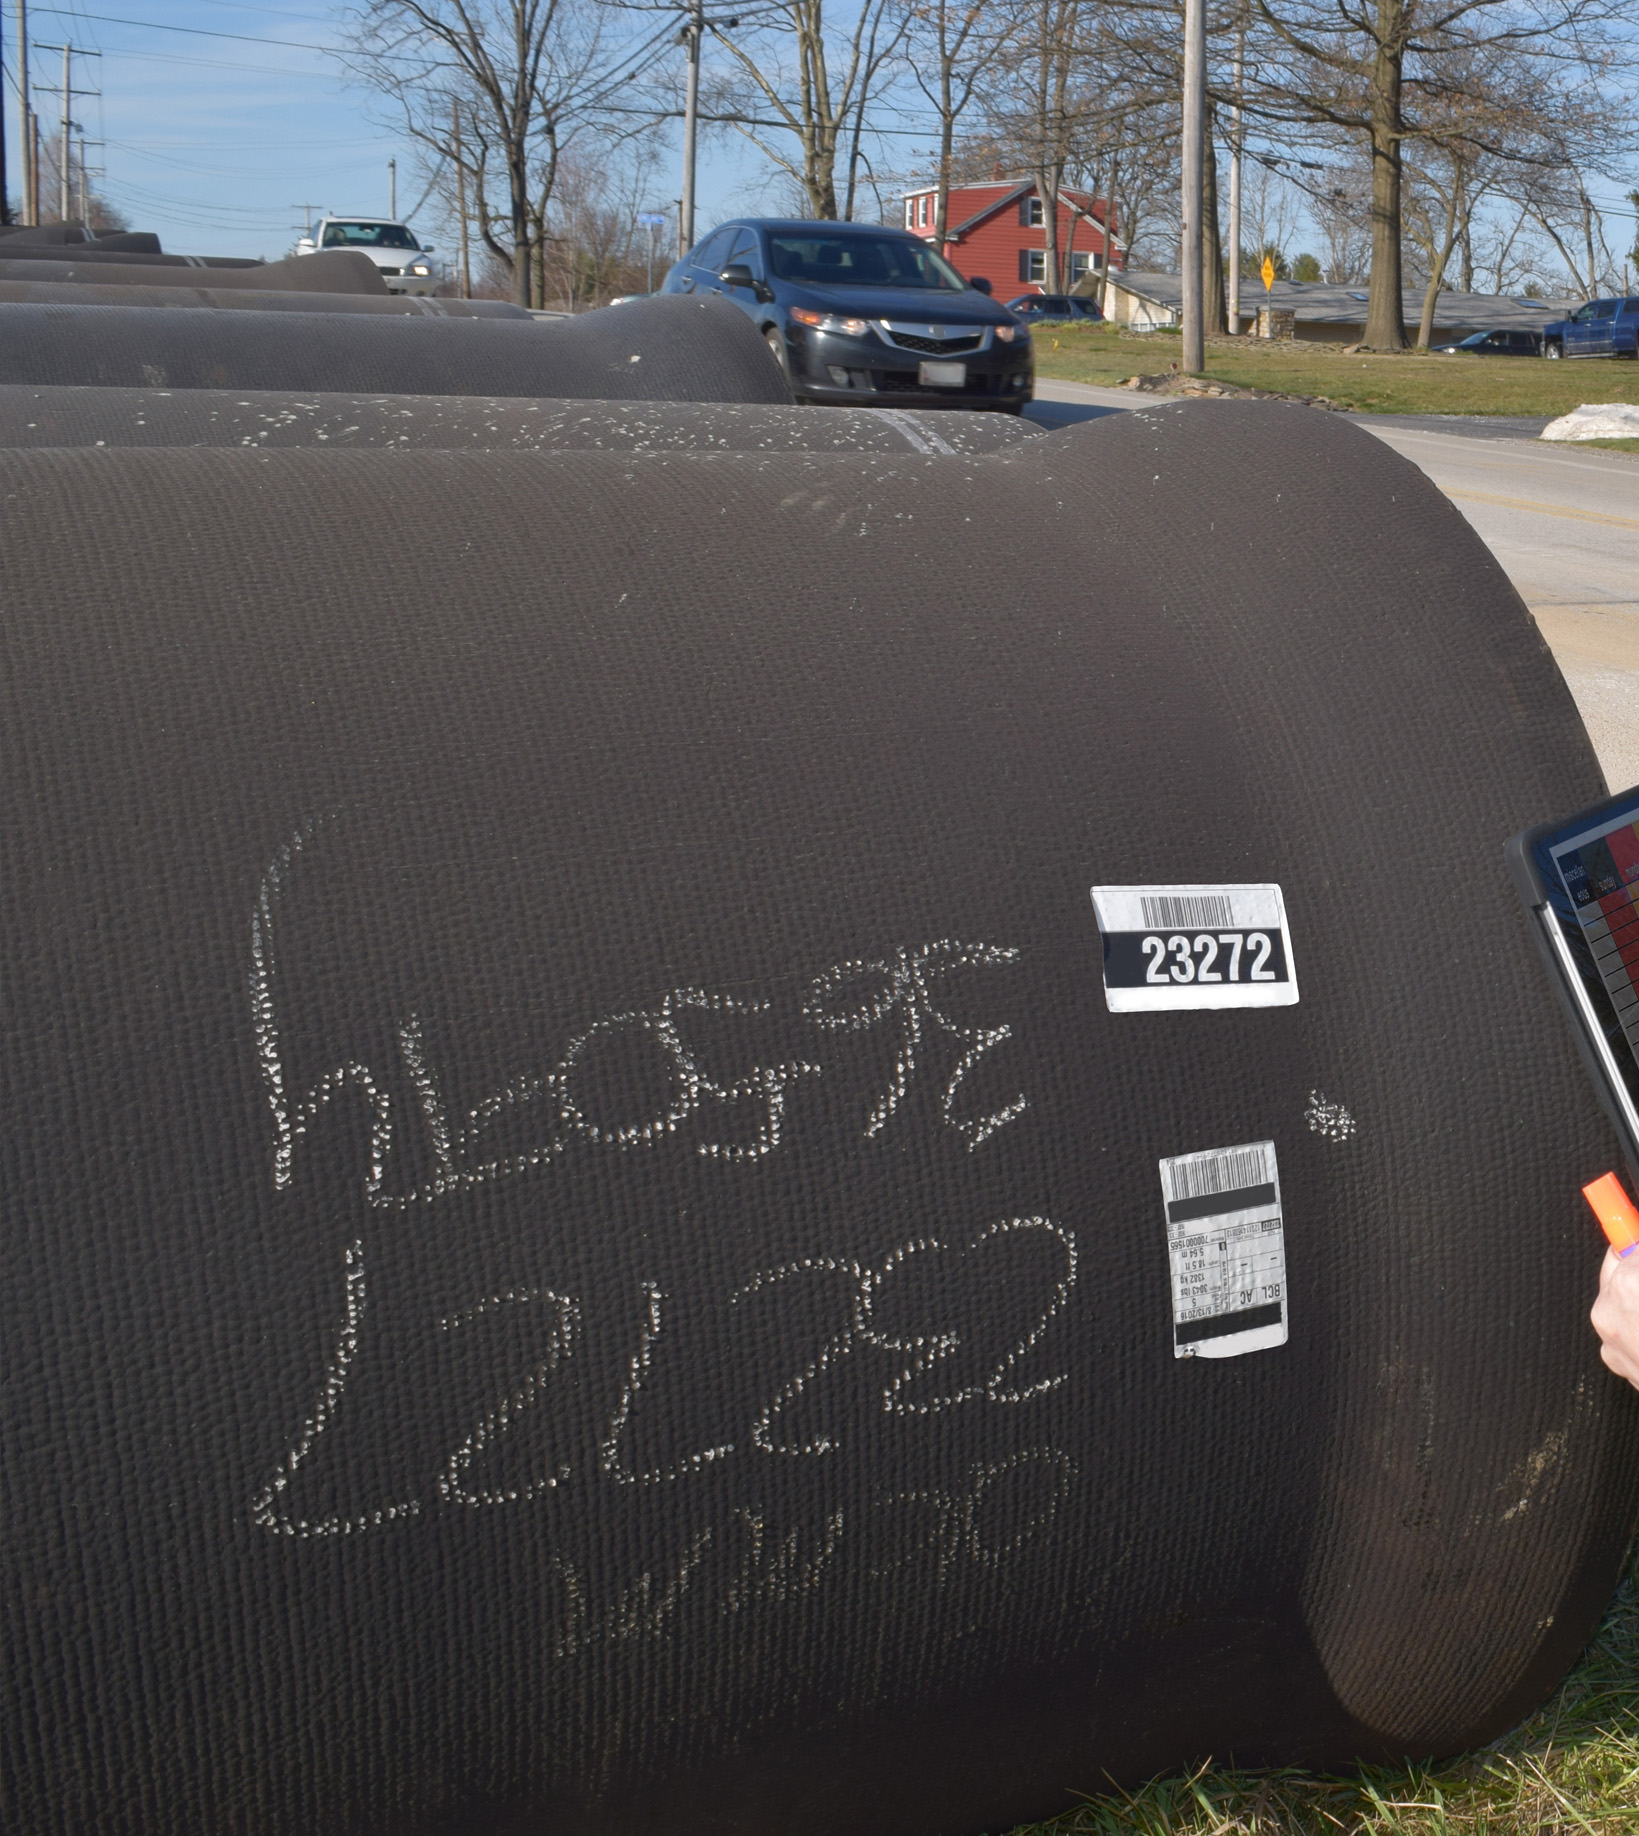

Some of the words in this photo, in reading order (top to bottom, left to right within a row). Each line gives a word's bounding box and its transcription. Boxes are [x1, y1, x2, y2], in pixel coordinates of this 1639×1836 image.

[1599, 875, 1617, 892] sunday
[1142, 933, 1275, 983] 23272
[1189, 1248, 1204, 1258] 5.64
[1192, 1260, 1205, 1269] 18.5
[1180, 1276, 1189, 1285] kg
[1190, 1273, 1205, 1283] 1382
[1180, 1288, 1191, 1296] lbs
[1192, 1284, 1208, 1294] 3043
[1262, 1284, 1280, 1300] BCL
[1192, 1298, 1197, 1306] 5
[1239, 1290, 1253, 1304] AC
[1180, 1307, 1212, 1320] 8/13/2016
